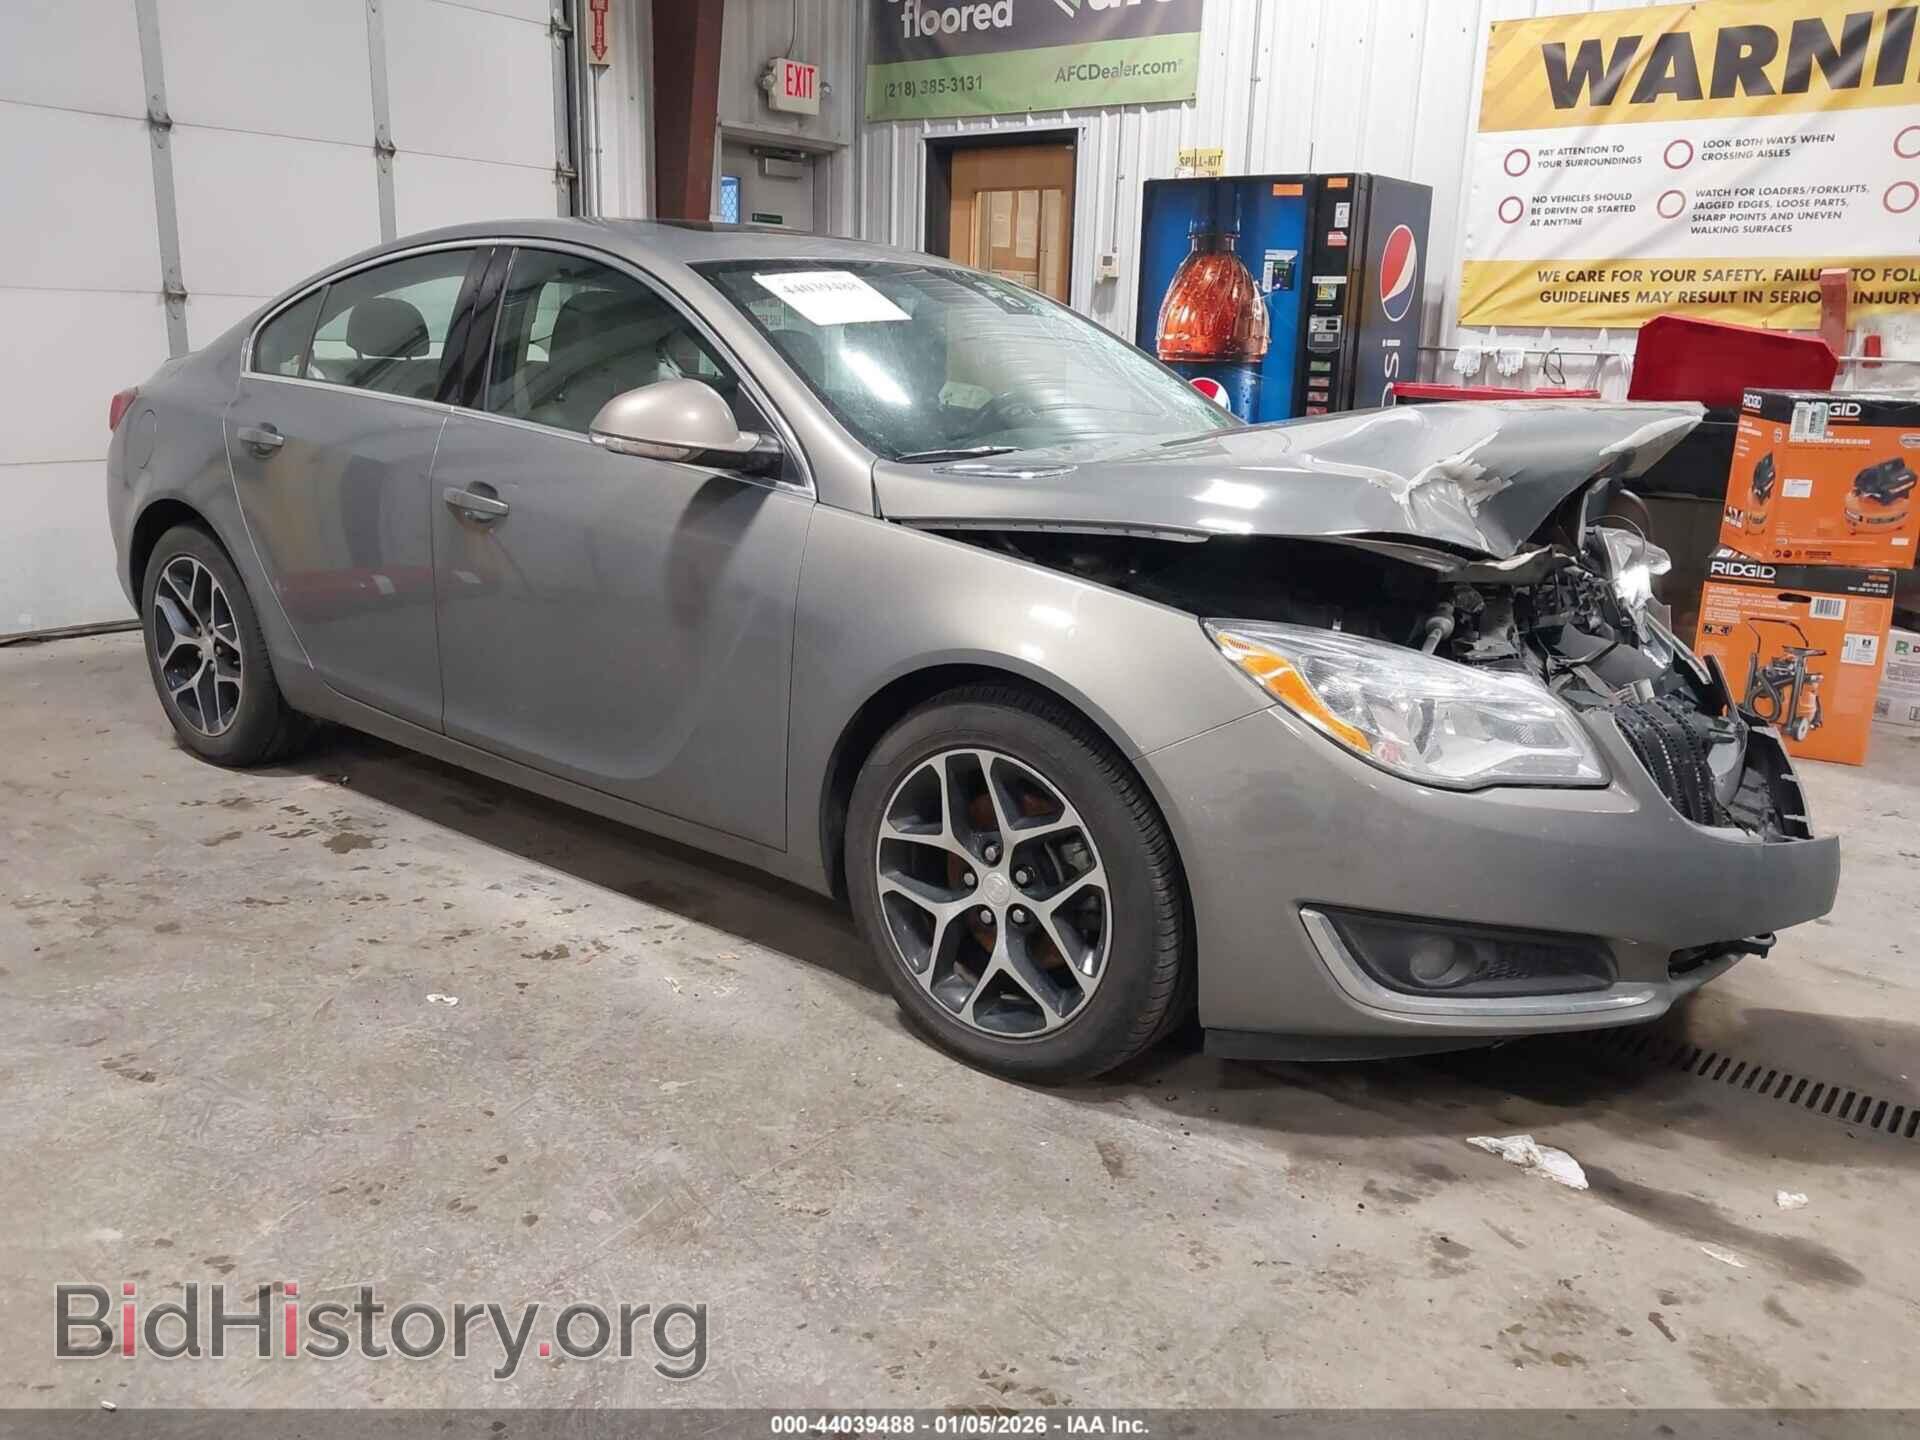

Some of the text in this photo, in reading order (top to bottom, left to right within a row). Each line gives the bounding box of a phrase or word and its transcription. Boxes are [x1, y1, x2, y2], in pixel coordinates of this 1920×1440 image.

[901, 0, 1013, 38] floored
[1542, 6, 1920, 109] WARNI
[787, 64, 815, 99] EXIT
[884, 75, 983, 97] (218) 385-3131
[1702, 134, 1835, 149] LOOK BOTH WAYS WHEN
[1538, 145, 1625, 157] PAY ATTENTION TO
[1701, 149, 1791, 161] CROSSING AISLES
[1537, 156, 1642, 168] YOUR SURROUNDINGS
[1696, 184, 1870, 197] WATCH FOR LOADERS/FORKLIFTS,
[1532, 192, 1633, 204] NO VEHICLES SHOULD
[1693, 198, 1849, 210] JAGGED EDGES, LOOSE PARTS,
[1531, 204, 1637, 215] BE DRIVEN OR STARTED
[1530, 217, 1583, 227] AT ANYTIME
[1692, 211, 1842, 222] SHARP POINTS AND UNEVEN
[1690, 224, 1793, 235] WALKING SURFACES
[1537, 268, 1920, 283] WE CARE FOR YOUR SAFETY. FAILU TO FOL
[1539, 290, 1920, 304] GUIDELINES MAY RESULT IN SERIO INJURY
[1710, 561, 1777, 578] RIDGID
